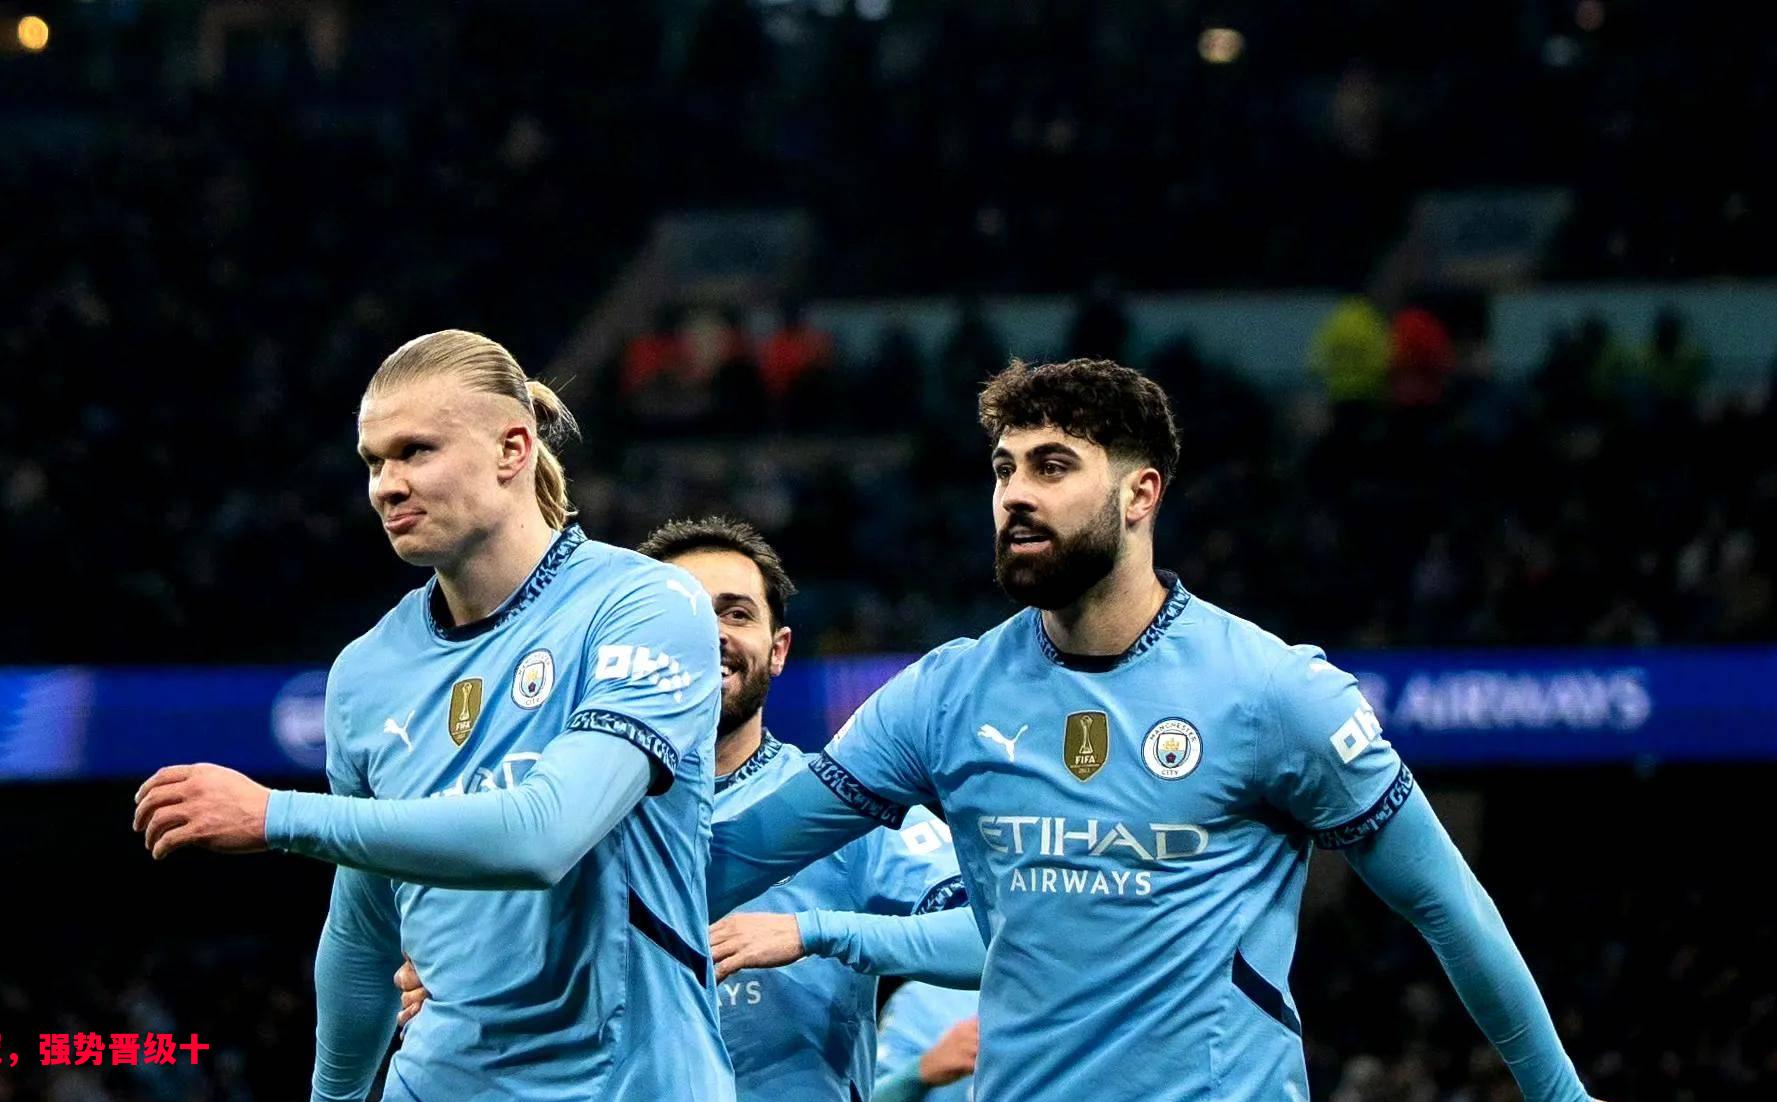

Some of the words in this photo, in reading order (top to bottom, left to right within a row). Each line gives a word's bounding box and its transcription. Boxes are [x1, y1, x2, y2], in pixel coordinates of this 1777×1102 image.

[1395, 670, 1651, 730] AIRWAYS
[1075, 755, 1095, 764] FIFA
[977, 815, 1208, 861] ETIHAD
[1010, 867, 1152, 896] AIRWAYS
